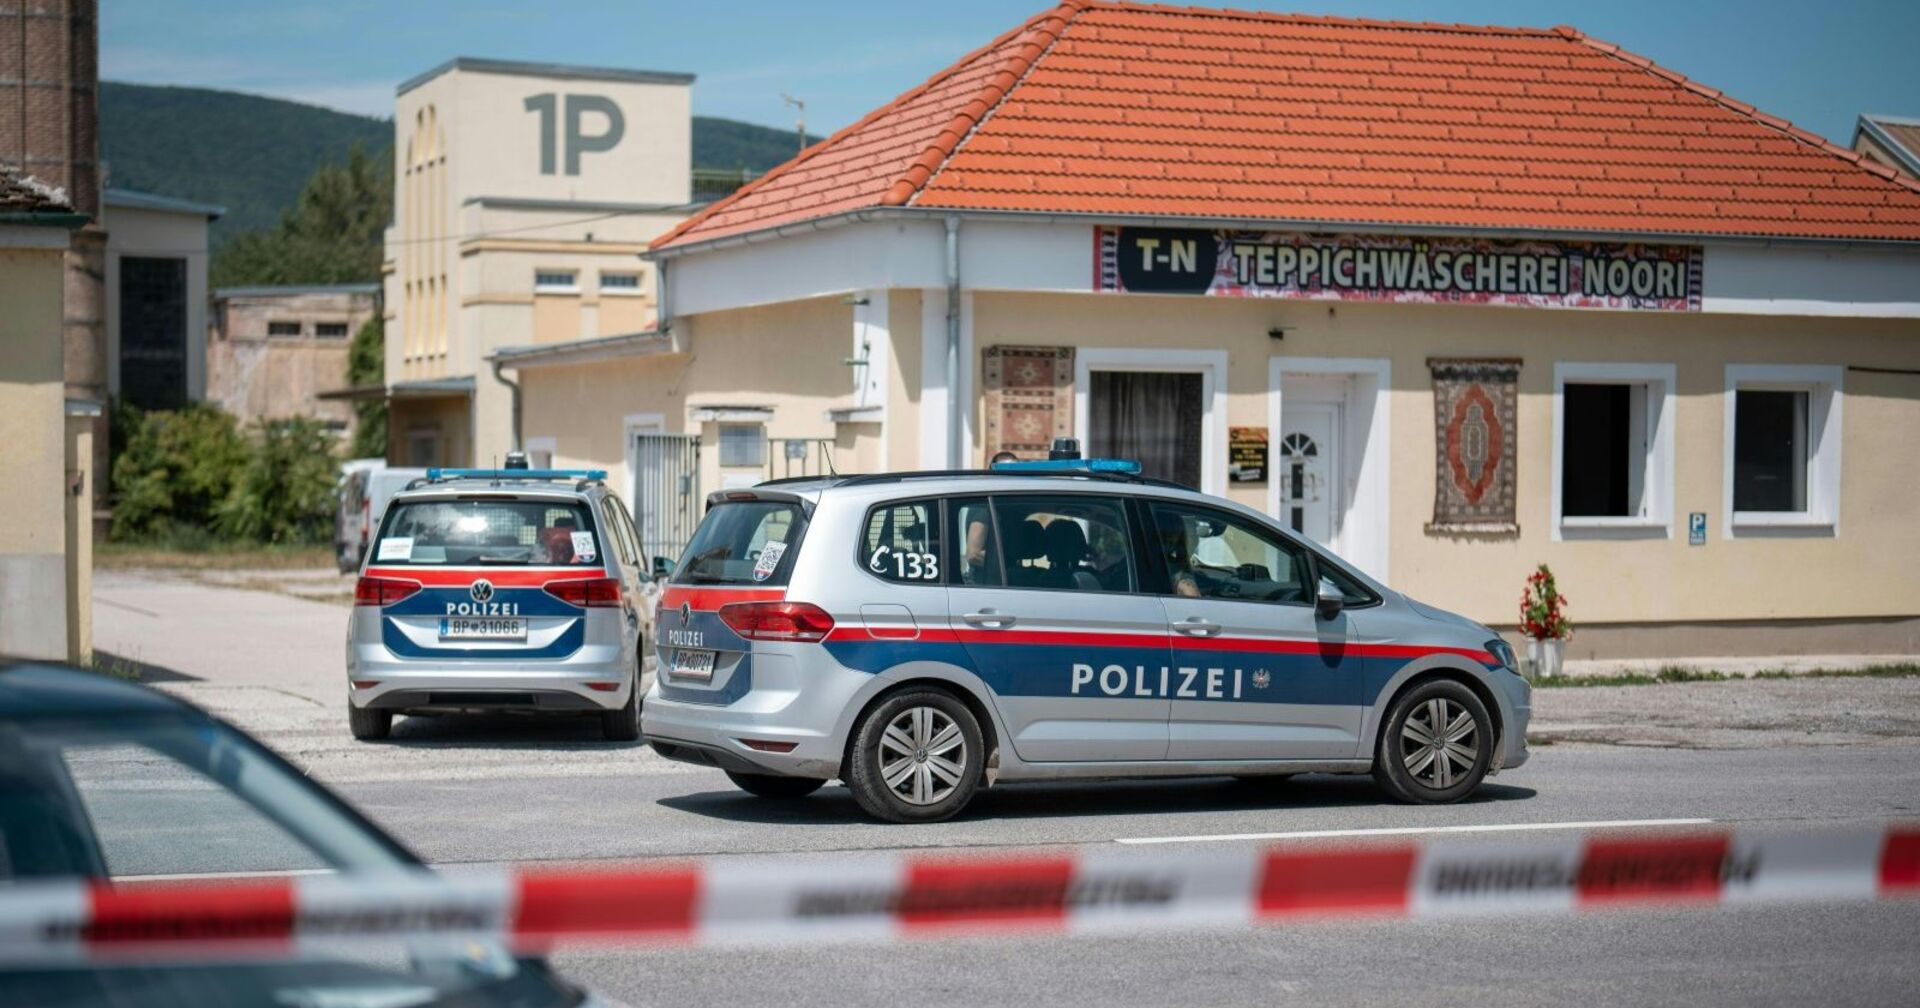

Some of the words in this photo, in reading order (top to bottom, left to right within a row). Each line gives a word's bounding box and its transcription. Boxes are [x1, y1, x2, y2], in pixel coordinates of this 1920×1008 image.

[523, 92, 626, 176] 1P
[1136, 238, 1197, 273] T-N
[1233, 243, 1569, 295] TEPPICHWÄSCHEREI
[1585, 258, 1686, 297] NOORI
[892, 552, 938, 579] 133
[446, 602, 519, 616] POLIZEI
[479, 620, 519, 635] 31066
[668, 629, 703, 647] POLIZEI
[1071, 663, 1243, 699] POLIZEI
